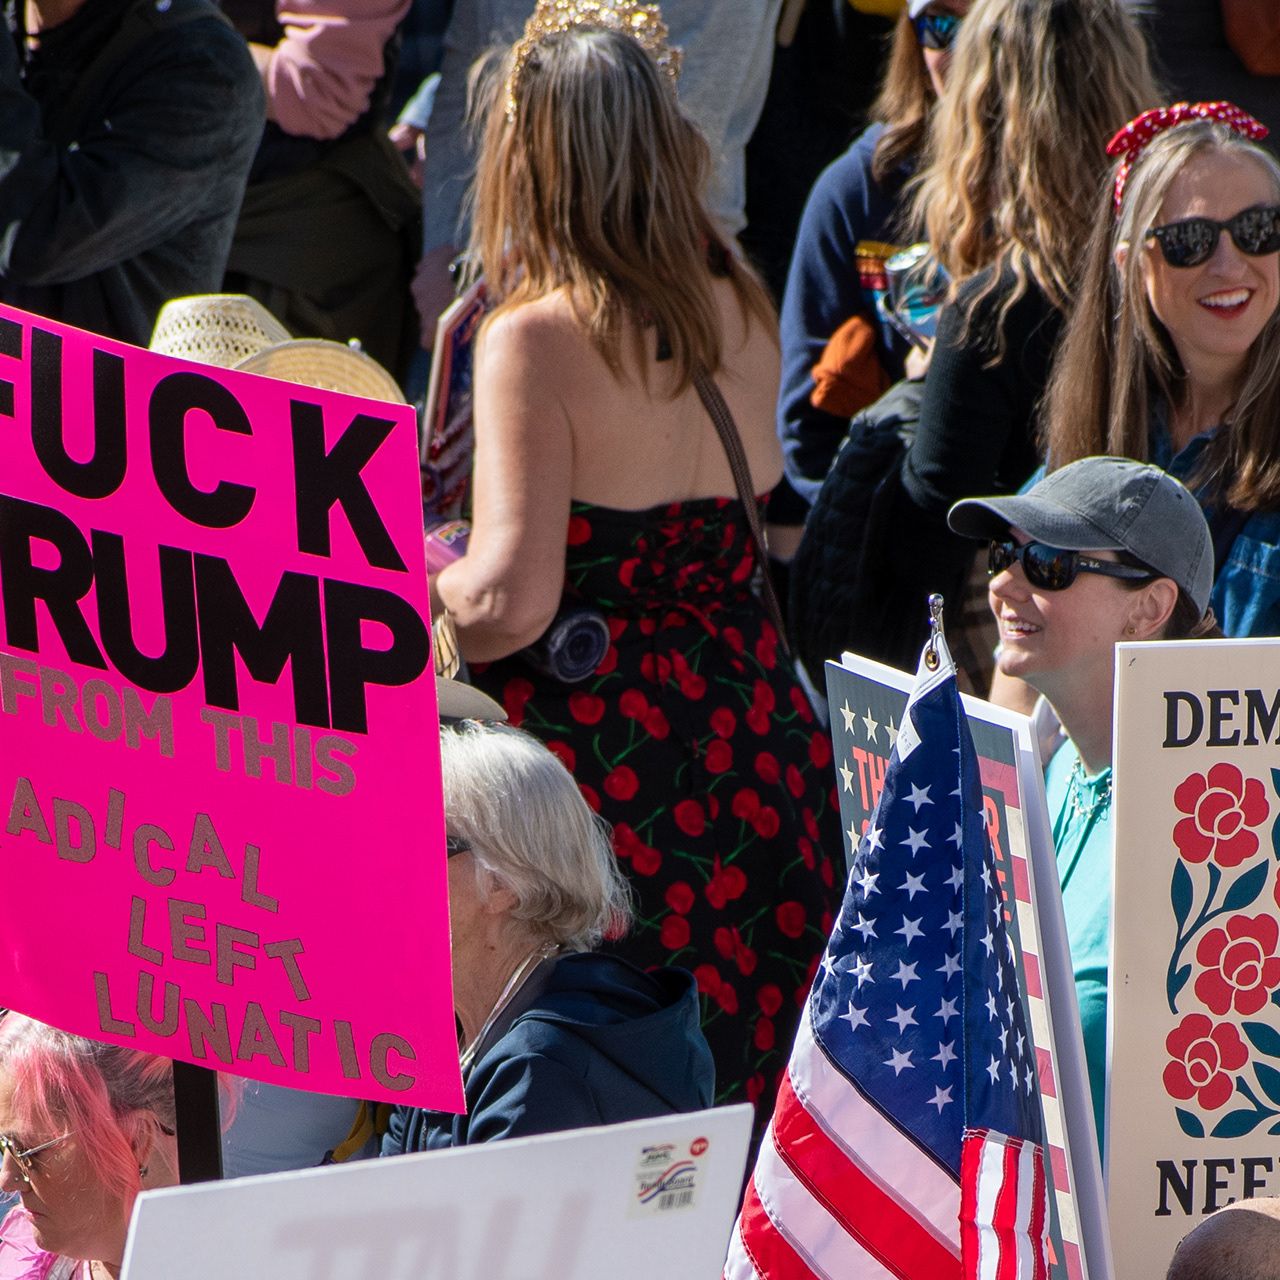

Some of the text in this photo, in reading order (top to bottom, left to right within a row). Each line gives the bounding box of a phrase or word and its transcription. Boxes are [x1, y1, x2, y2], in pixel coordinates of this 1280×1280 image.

[200, 707, 358, 797] THIS
[127, 895, 311, 1002] LEFT
[93, 970, 417, 1092] LUNATIC
